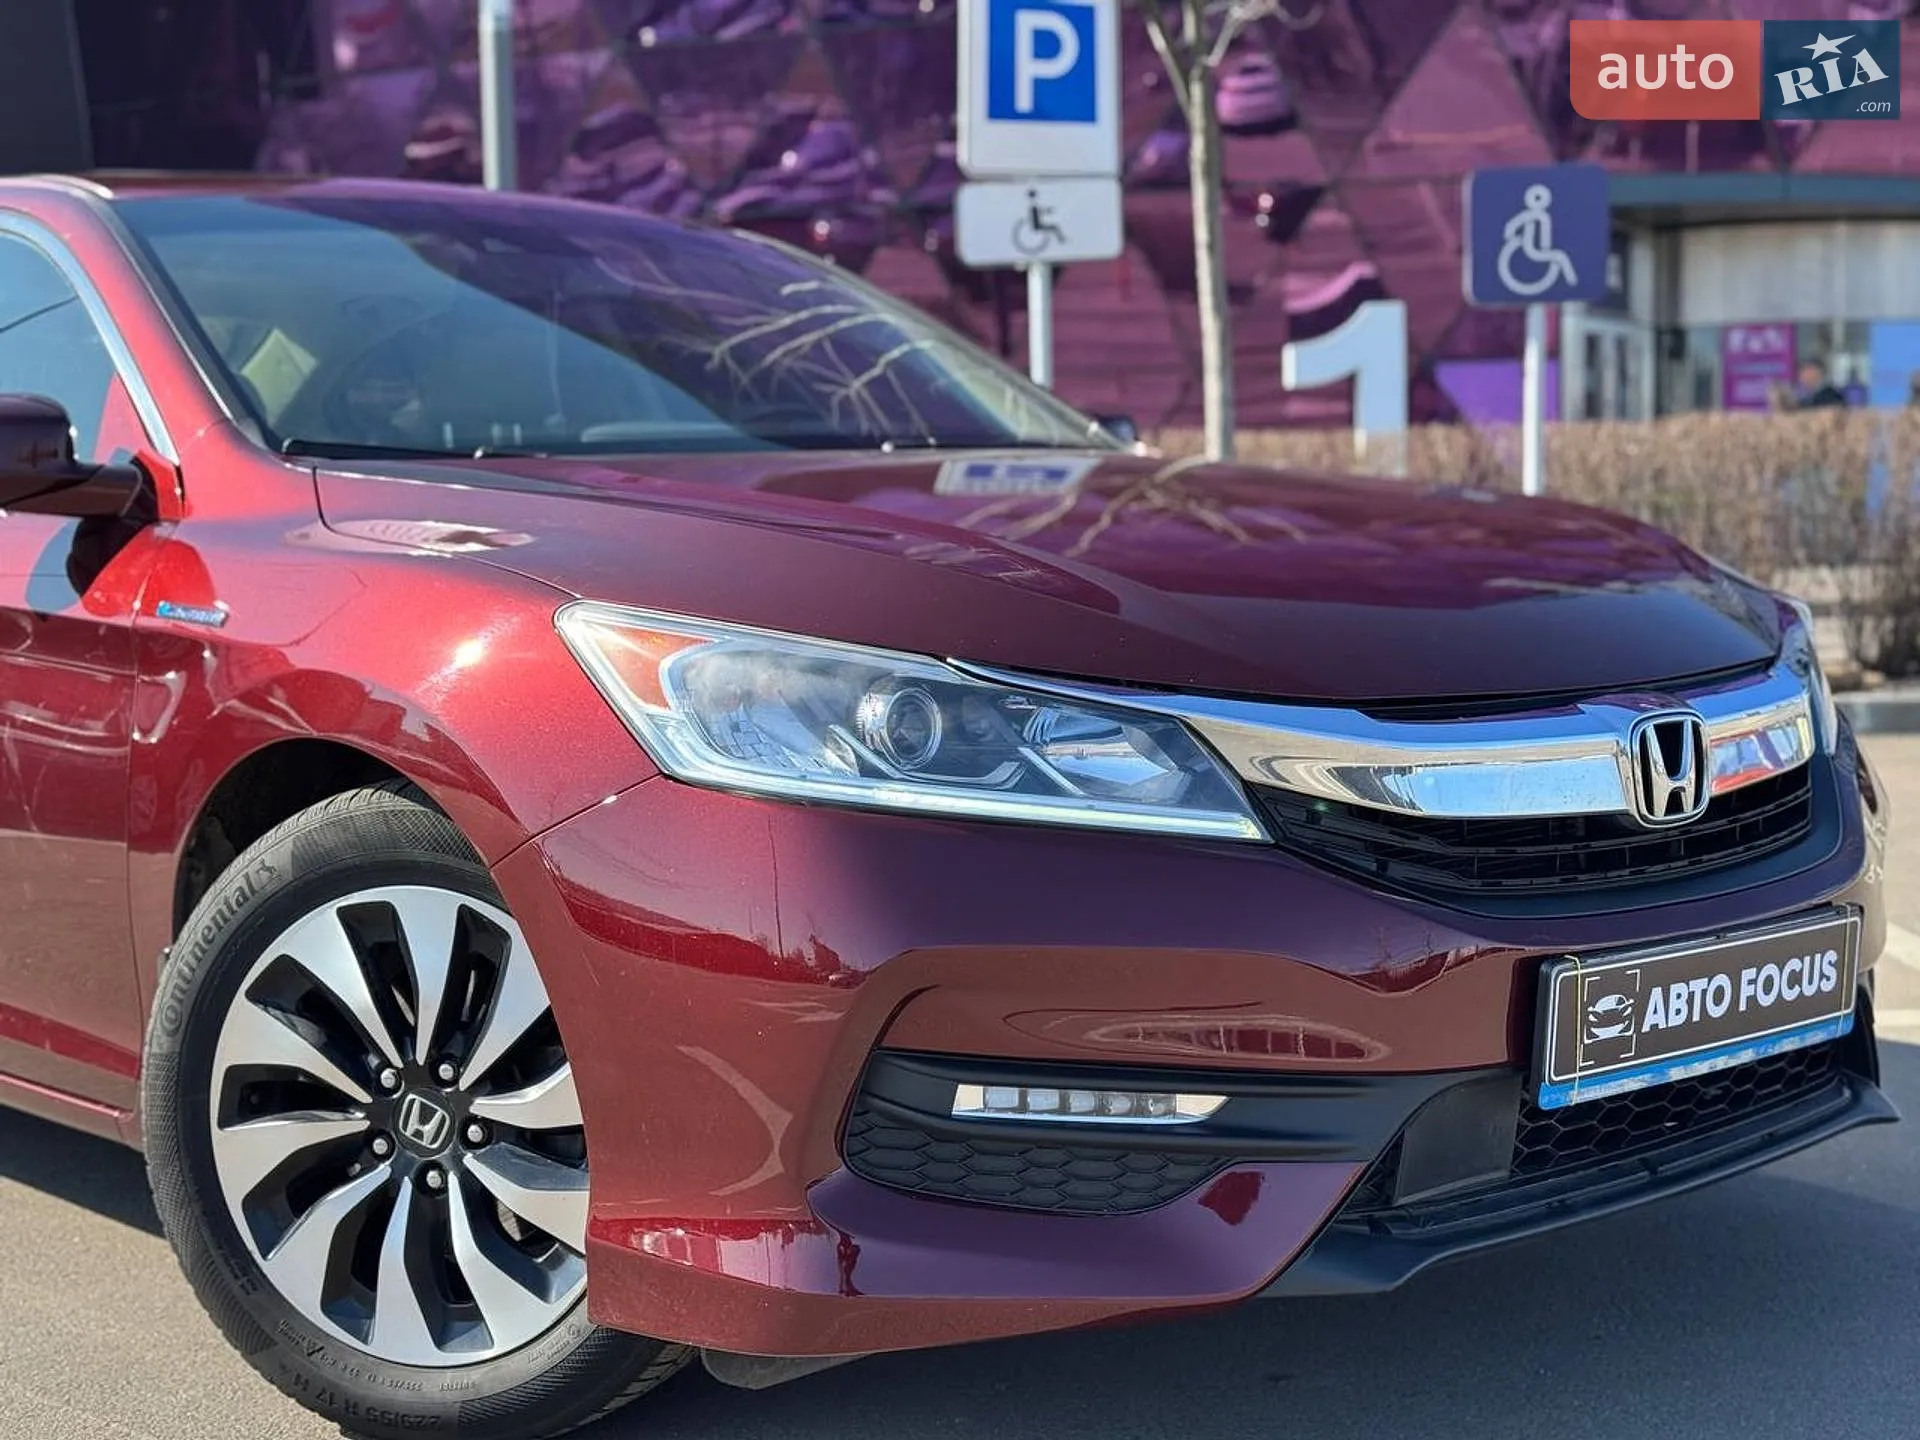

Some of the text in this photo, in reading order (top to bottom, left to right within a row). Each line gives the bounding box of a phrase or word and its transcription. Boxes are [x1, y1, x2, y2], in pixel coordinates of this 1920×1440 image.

[1014, 9, 1080, 113] P
[1281, 299, 1408, 477] 1
[160, 870, 259, 1038] Continental
[1738, 949, 1839, 1011] FOCUS
